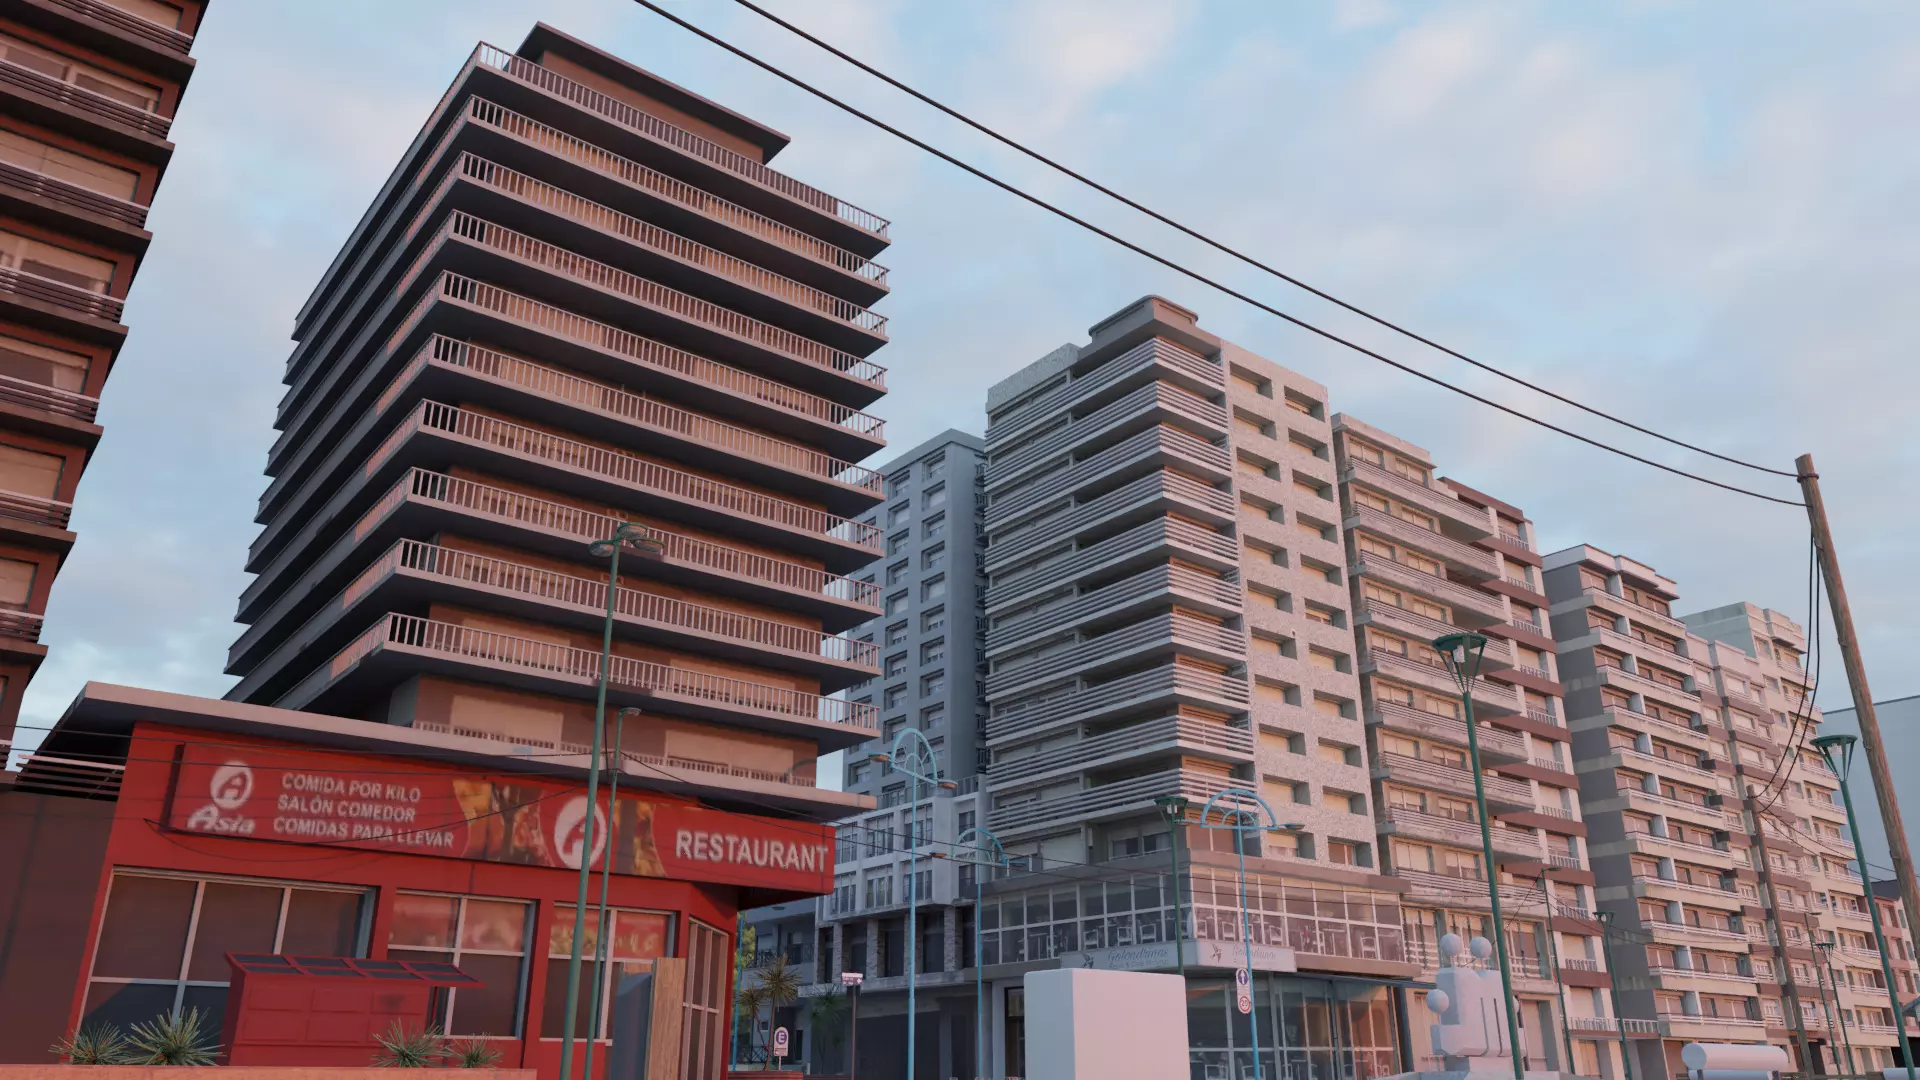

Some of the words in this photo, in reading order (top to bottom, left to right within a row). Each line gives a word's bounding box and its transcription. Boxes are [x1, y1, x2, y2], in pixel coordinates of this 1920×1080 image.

[282, 772, 345, 795] COMIDA
[348, 780, 382, 799] POR
[386, 783, 421, 803] KILO
[186, 804, 256, 833] Asia
[278, 793, 334, 816] SALÓN
[337, 800, 416, 823] COMEDOR
[273, 816, 349, 838] COMIDAS
[352, 823, 394, 842] PARA
[397, 827, 455, 849] LLEVAR
[675, 829, 829, 873] RESTAURANT
[778, 1032, 785, 1043] E
